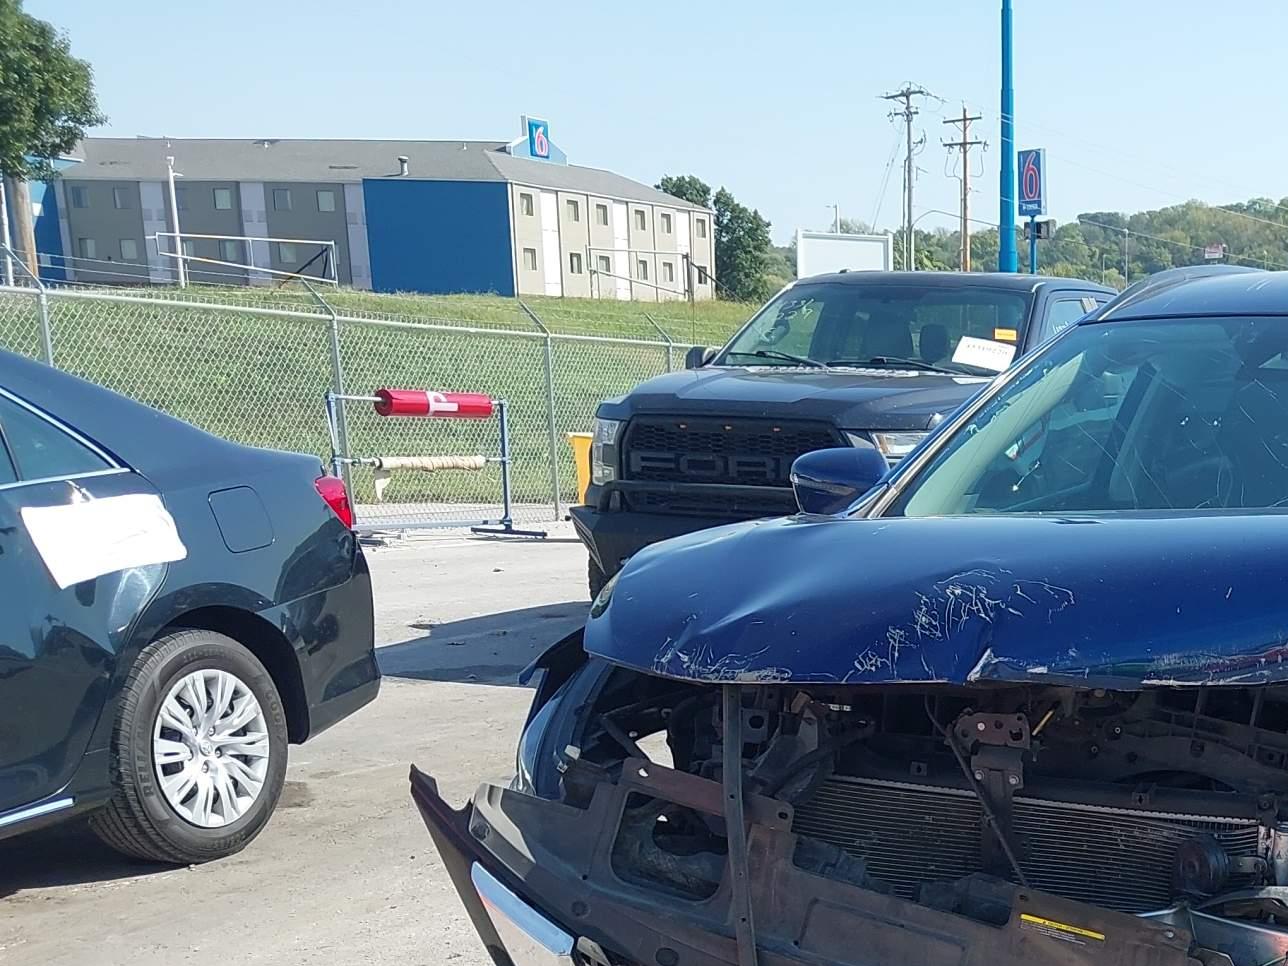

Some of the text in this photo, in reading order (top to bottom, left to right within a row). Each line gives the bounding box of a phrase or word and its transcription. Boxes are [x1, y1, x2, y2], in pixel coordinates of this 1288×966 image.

[535, 126, 549, 157] 6
[1023, 151, 1040, 201] 6
[630, 451, 791, 479] FOR
